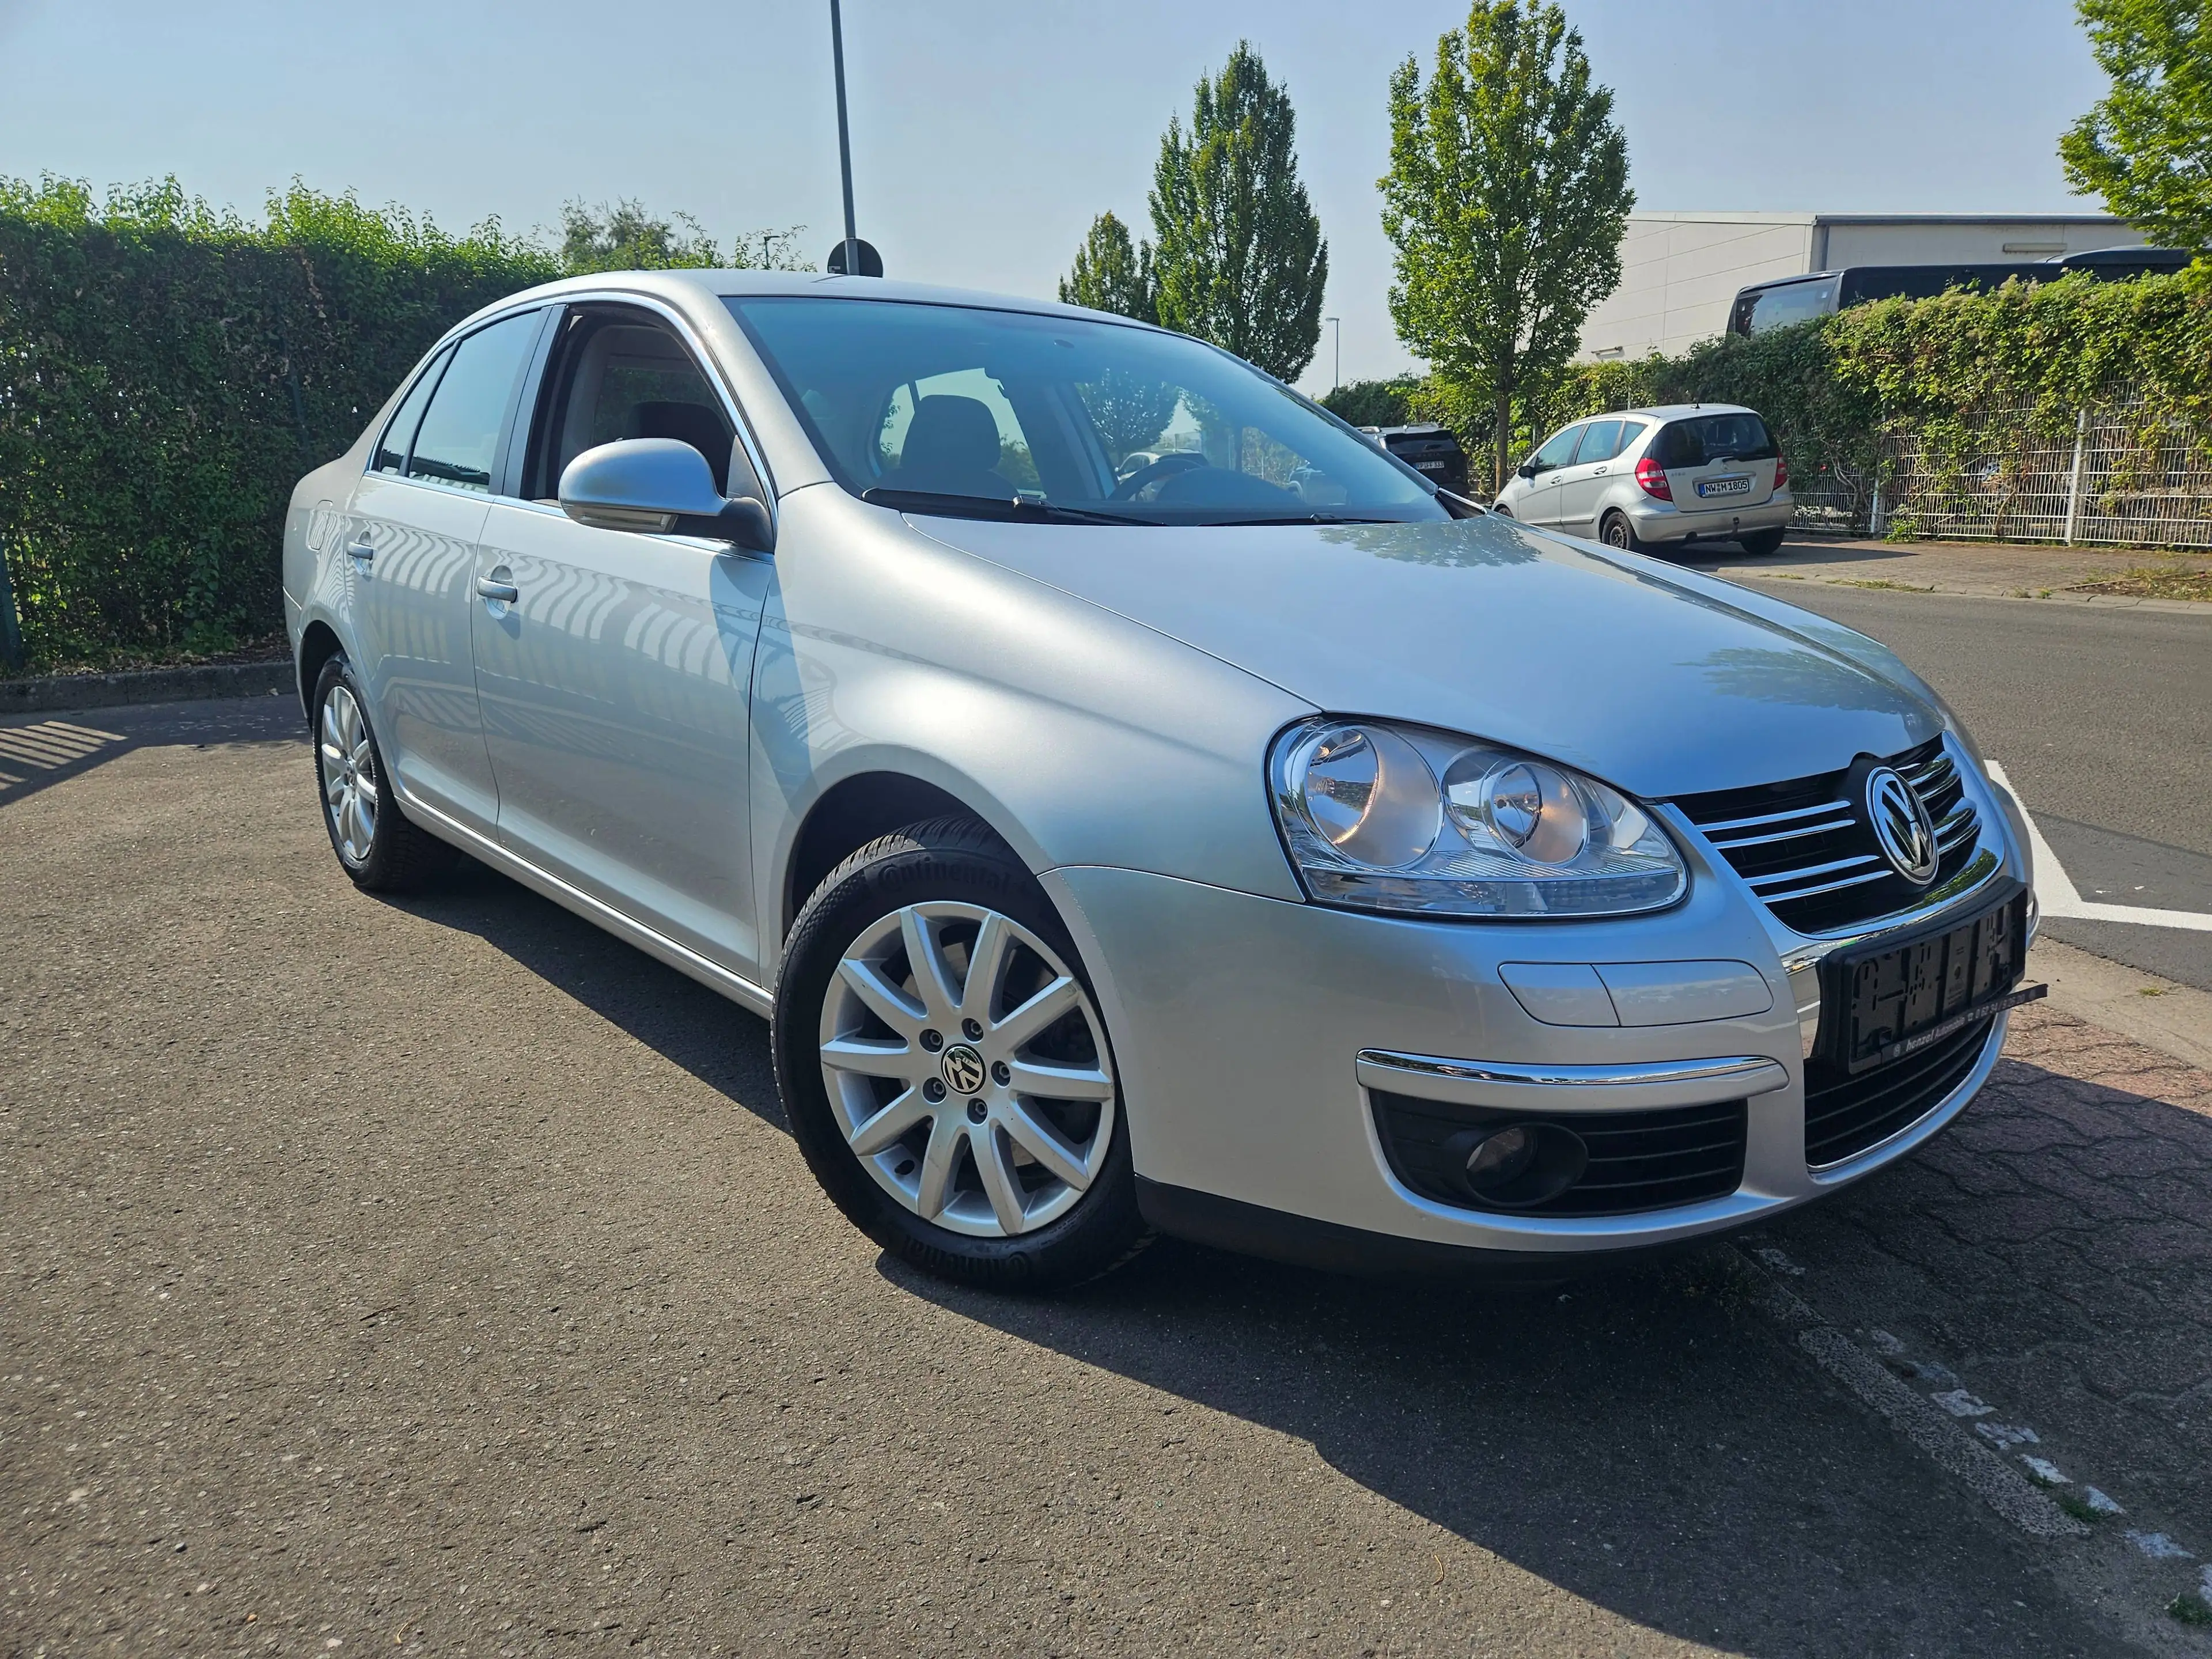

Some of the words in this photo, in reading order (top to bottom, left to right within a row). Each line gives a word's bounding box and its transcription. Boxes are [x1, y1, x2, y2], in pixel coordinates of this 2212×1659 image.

[1705, 483, 1716, 493] NW
[1721, 483, 1727, 491] M
[1728, 480, 1748, 491] 1805
[1870, 770, 1936, 880] VW
